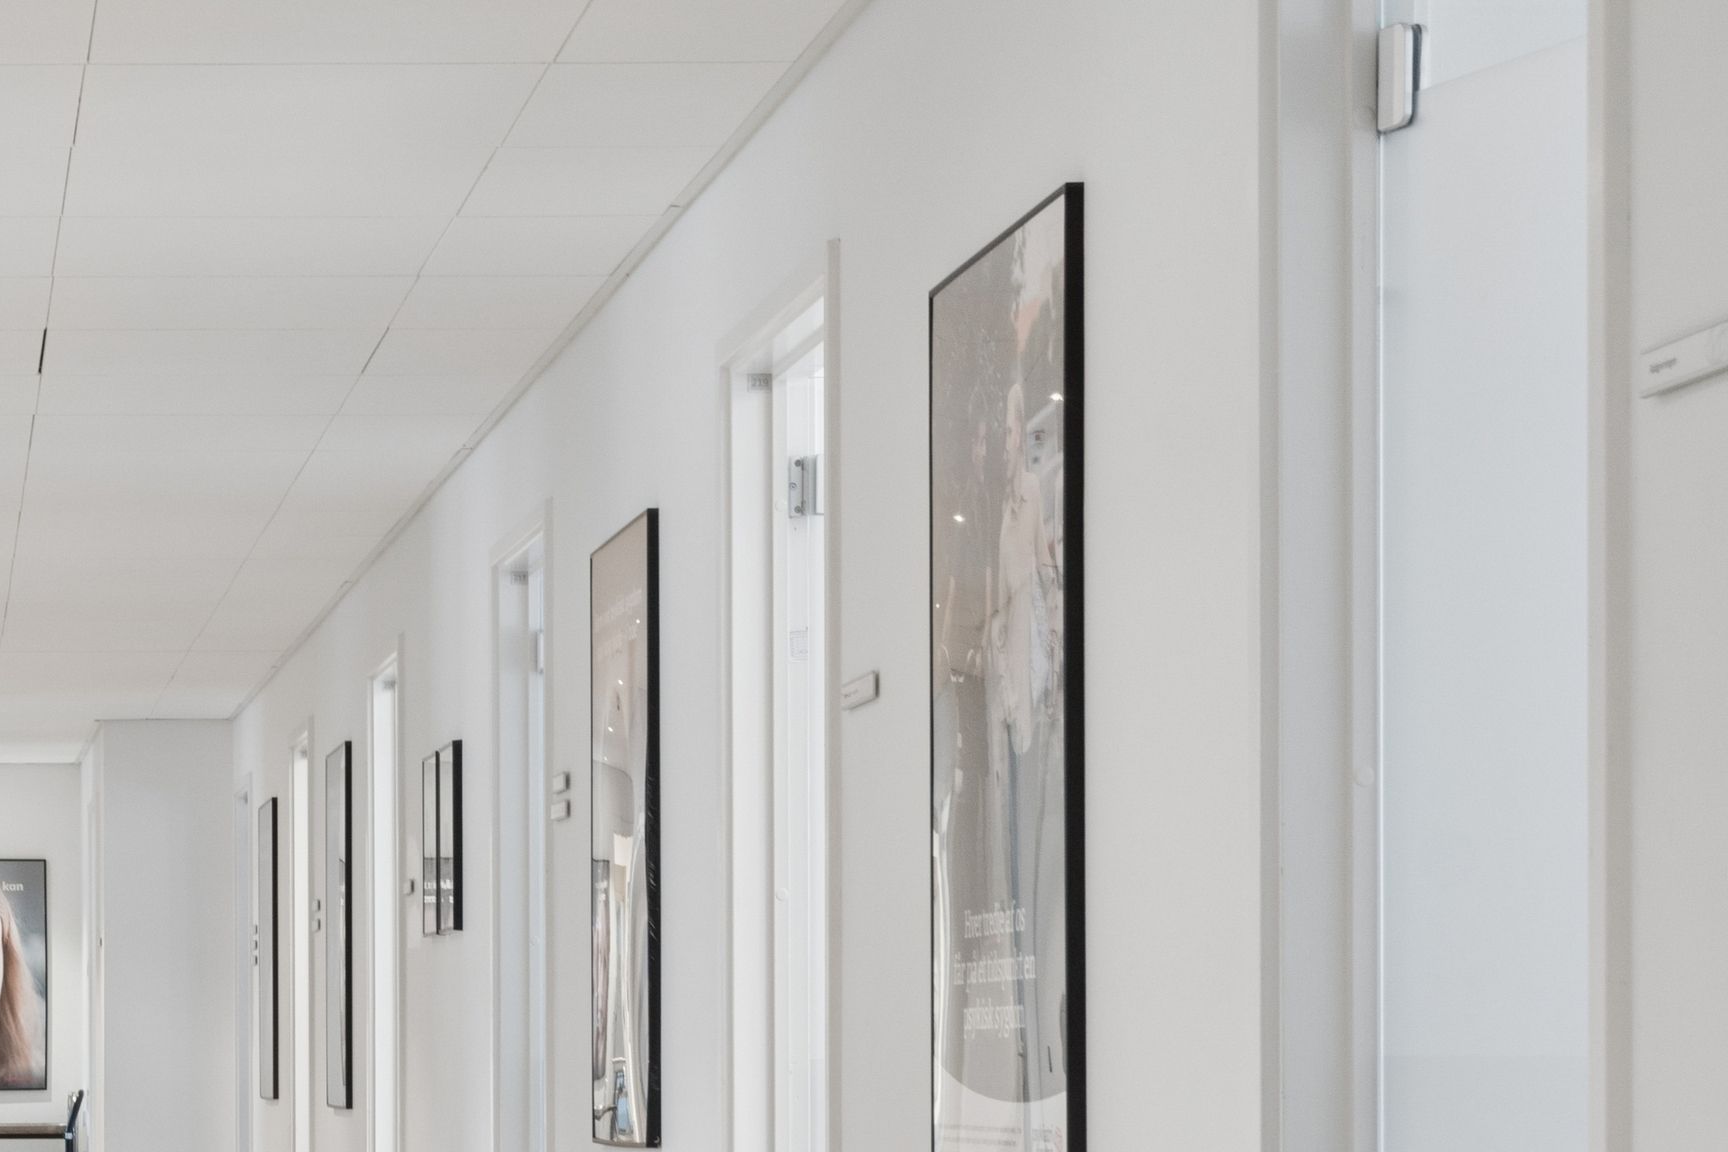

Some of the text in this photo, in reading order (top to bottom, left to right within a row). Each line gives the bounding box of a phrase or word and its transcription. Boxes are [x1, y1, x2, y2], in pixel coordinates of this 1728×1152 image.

[2, 881, 24, 891] kan
[1015, 907, 1026, 932] os
[1024, 954, 1036, 980] en
